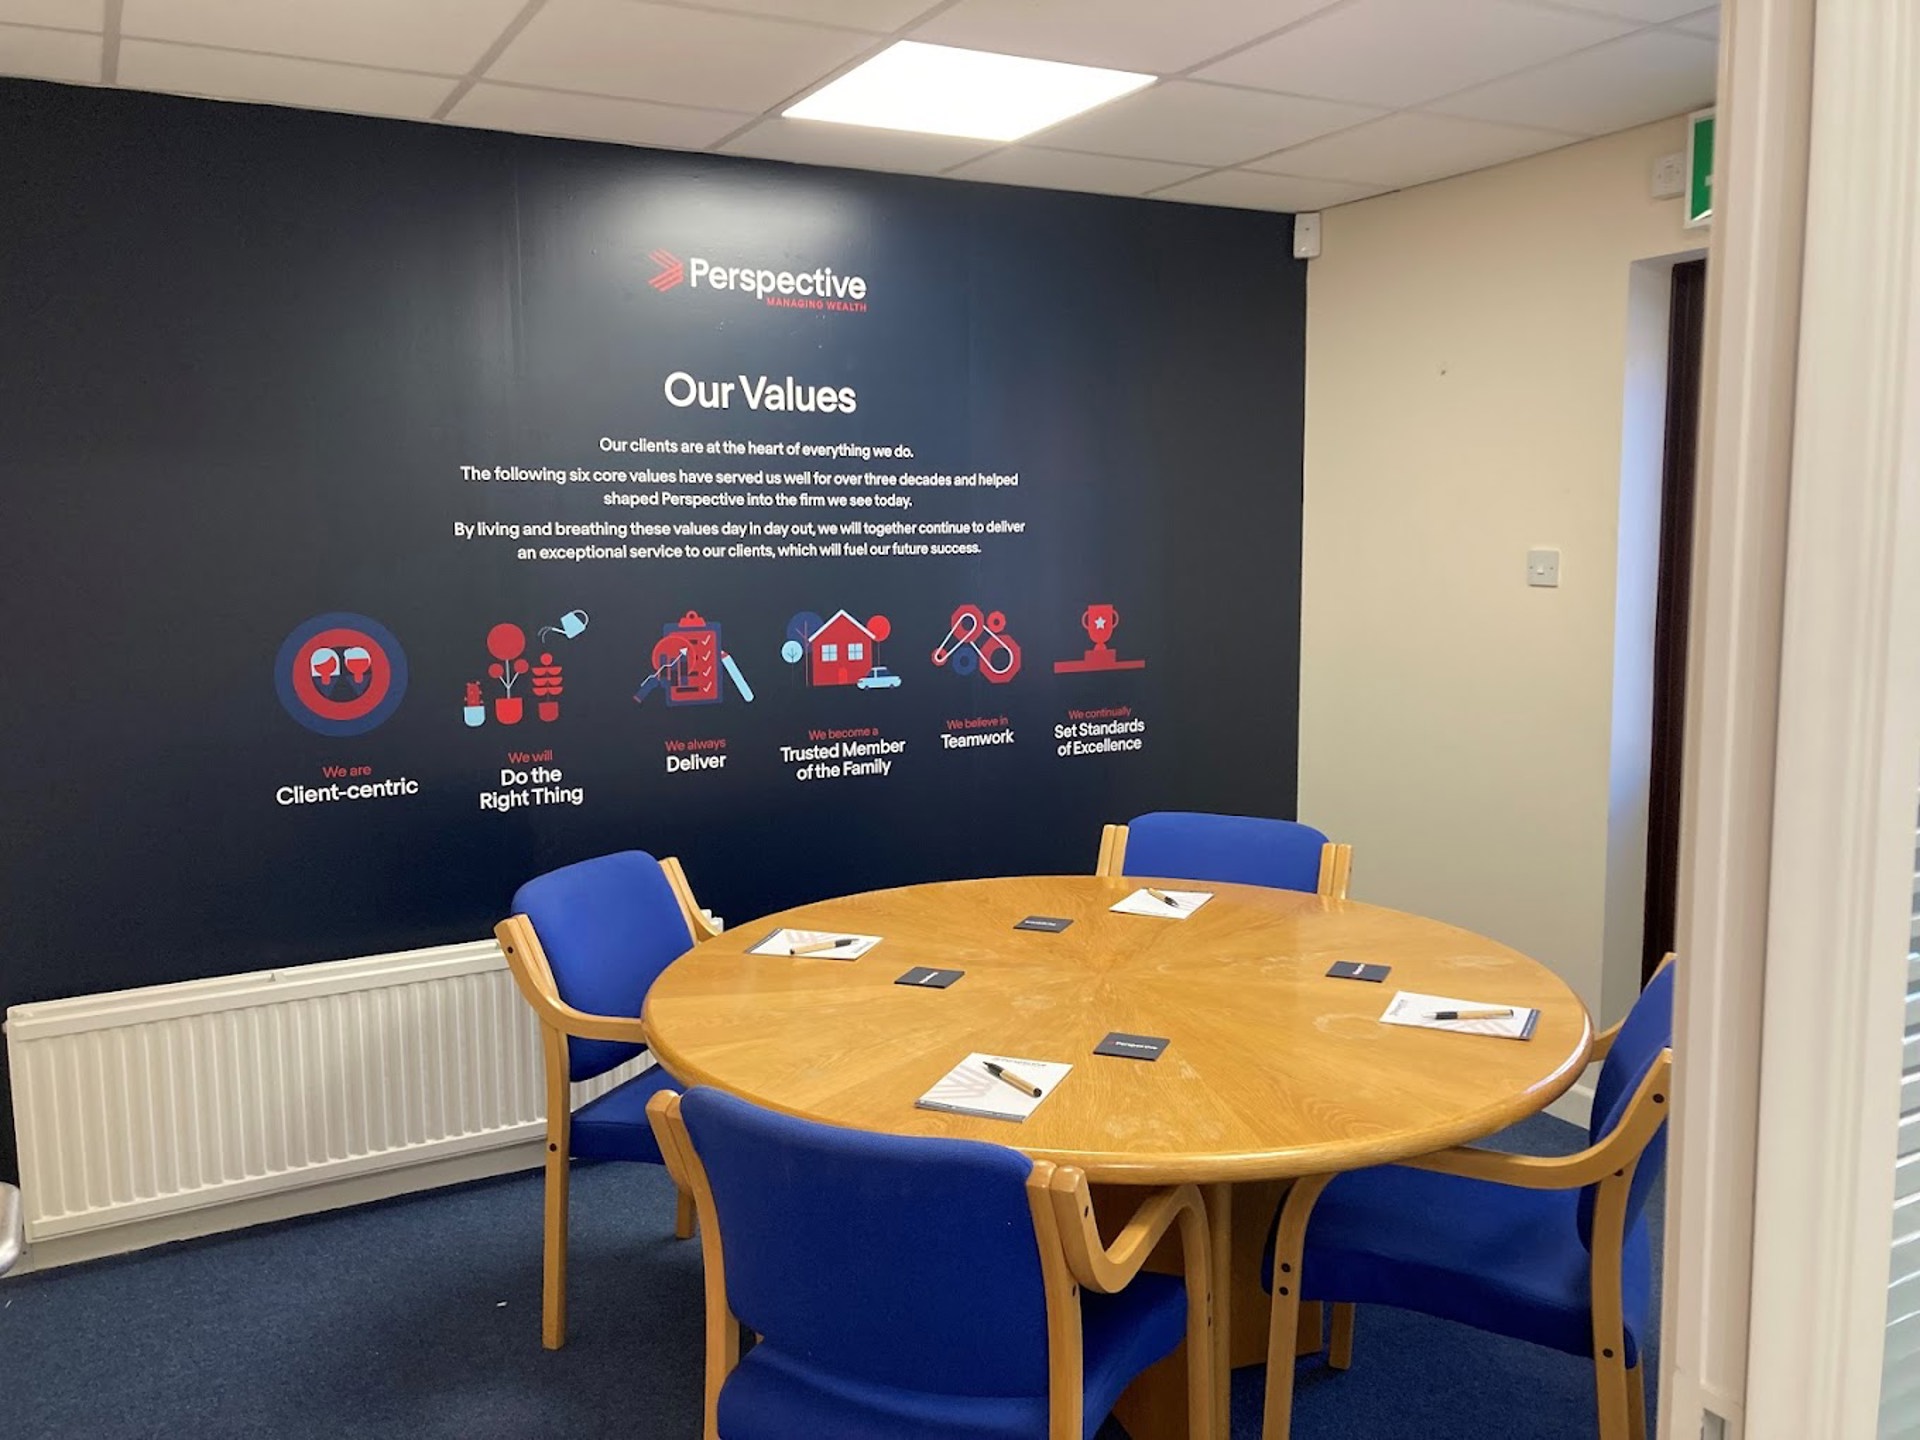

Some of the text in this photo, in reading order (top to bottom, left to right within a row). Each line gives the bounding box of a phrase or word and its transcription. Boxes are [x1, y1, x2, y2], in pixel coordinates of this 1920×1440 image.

[690, 258, 867, 300] Perspective
[766, 296, 867, 312] MANAGING WEALTH
[664, 371, 856, 413] Our Values
[600, 437, 914, 460] Our clients are at the heart of everything we do.
[460, 466, 1018, 488] The following six core values have served us well for over three decades and helped
[604, 491, 912, 510] shaped Perspective into the firm we see today.
[454, 520, 1026, 540] By living and breathing these values day in day out, we will together continue to deliver
[517, 542, 982, 562] an exceptional service to our clients, which will fuel our future success.
[947, 715, 1009, 730] We believe in
[1068, 706, 1131, 720] We continually
[808, 728, 879, 740] We become a
[940, 728, 1014, 748] Teamwork
[1054, 718, 1145, 739] Set Standards
[665, 739, 726, 751] We always
[780, 738, 906, 762] Trusted Member
[1057, 738, 1142, 757] of Excellence
[508, 750, 553, 763] We will
[666, 753, 727, 772] Deliver
[322, 766, 372, 778] We are
[501, 766, 562, 786] Do the
[796, 758, 892, 781] of the Family
[276, 777, 418, 805] Client-centric
[480, 786, 583, 812] Right Thing
